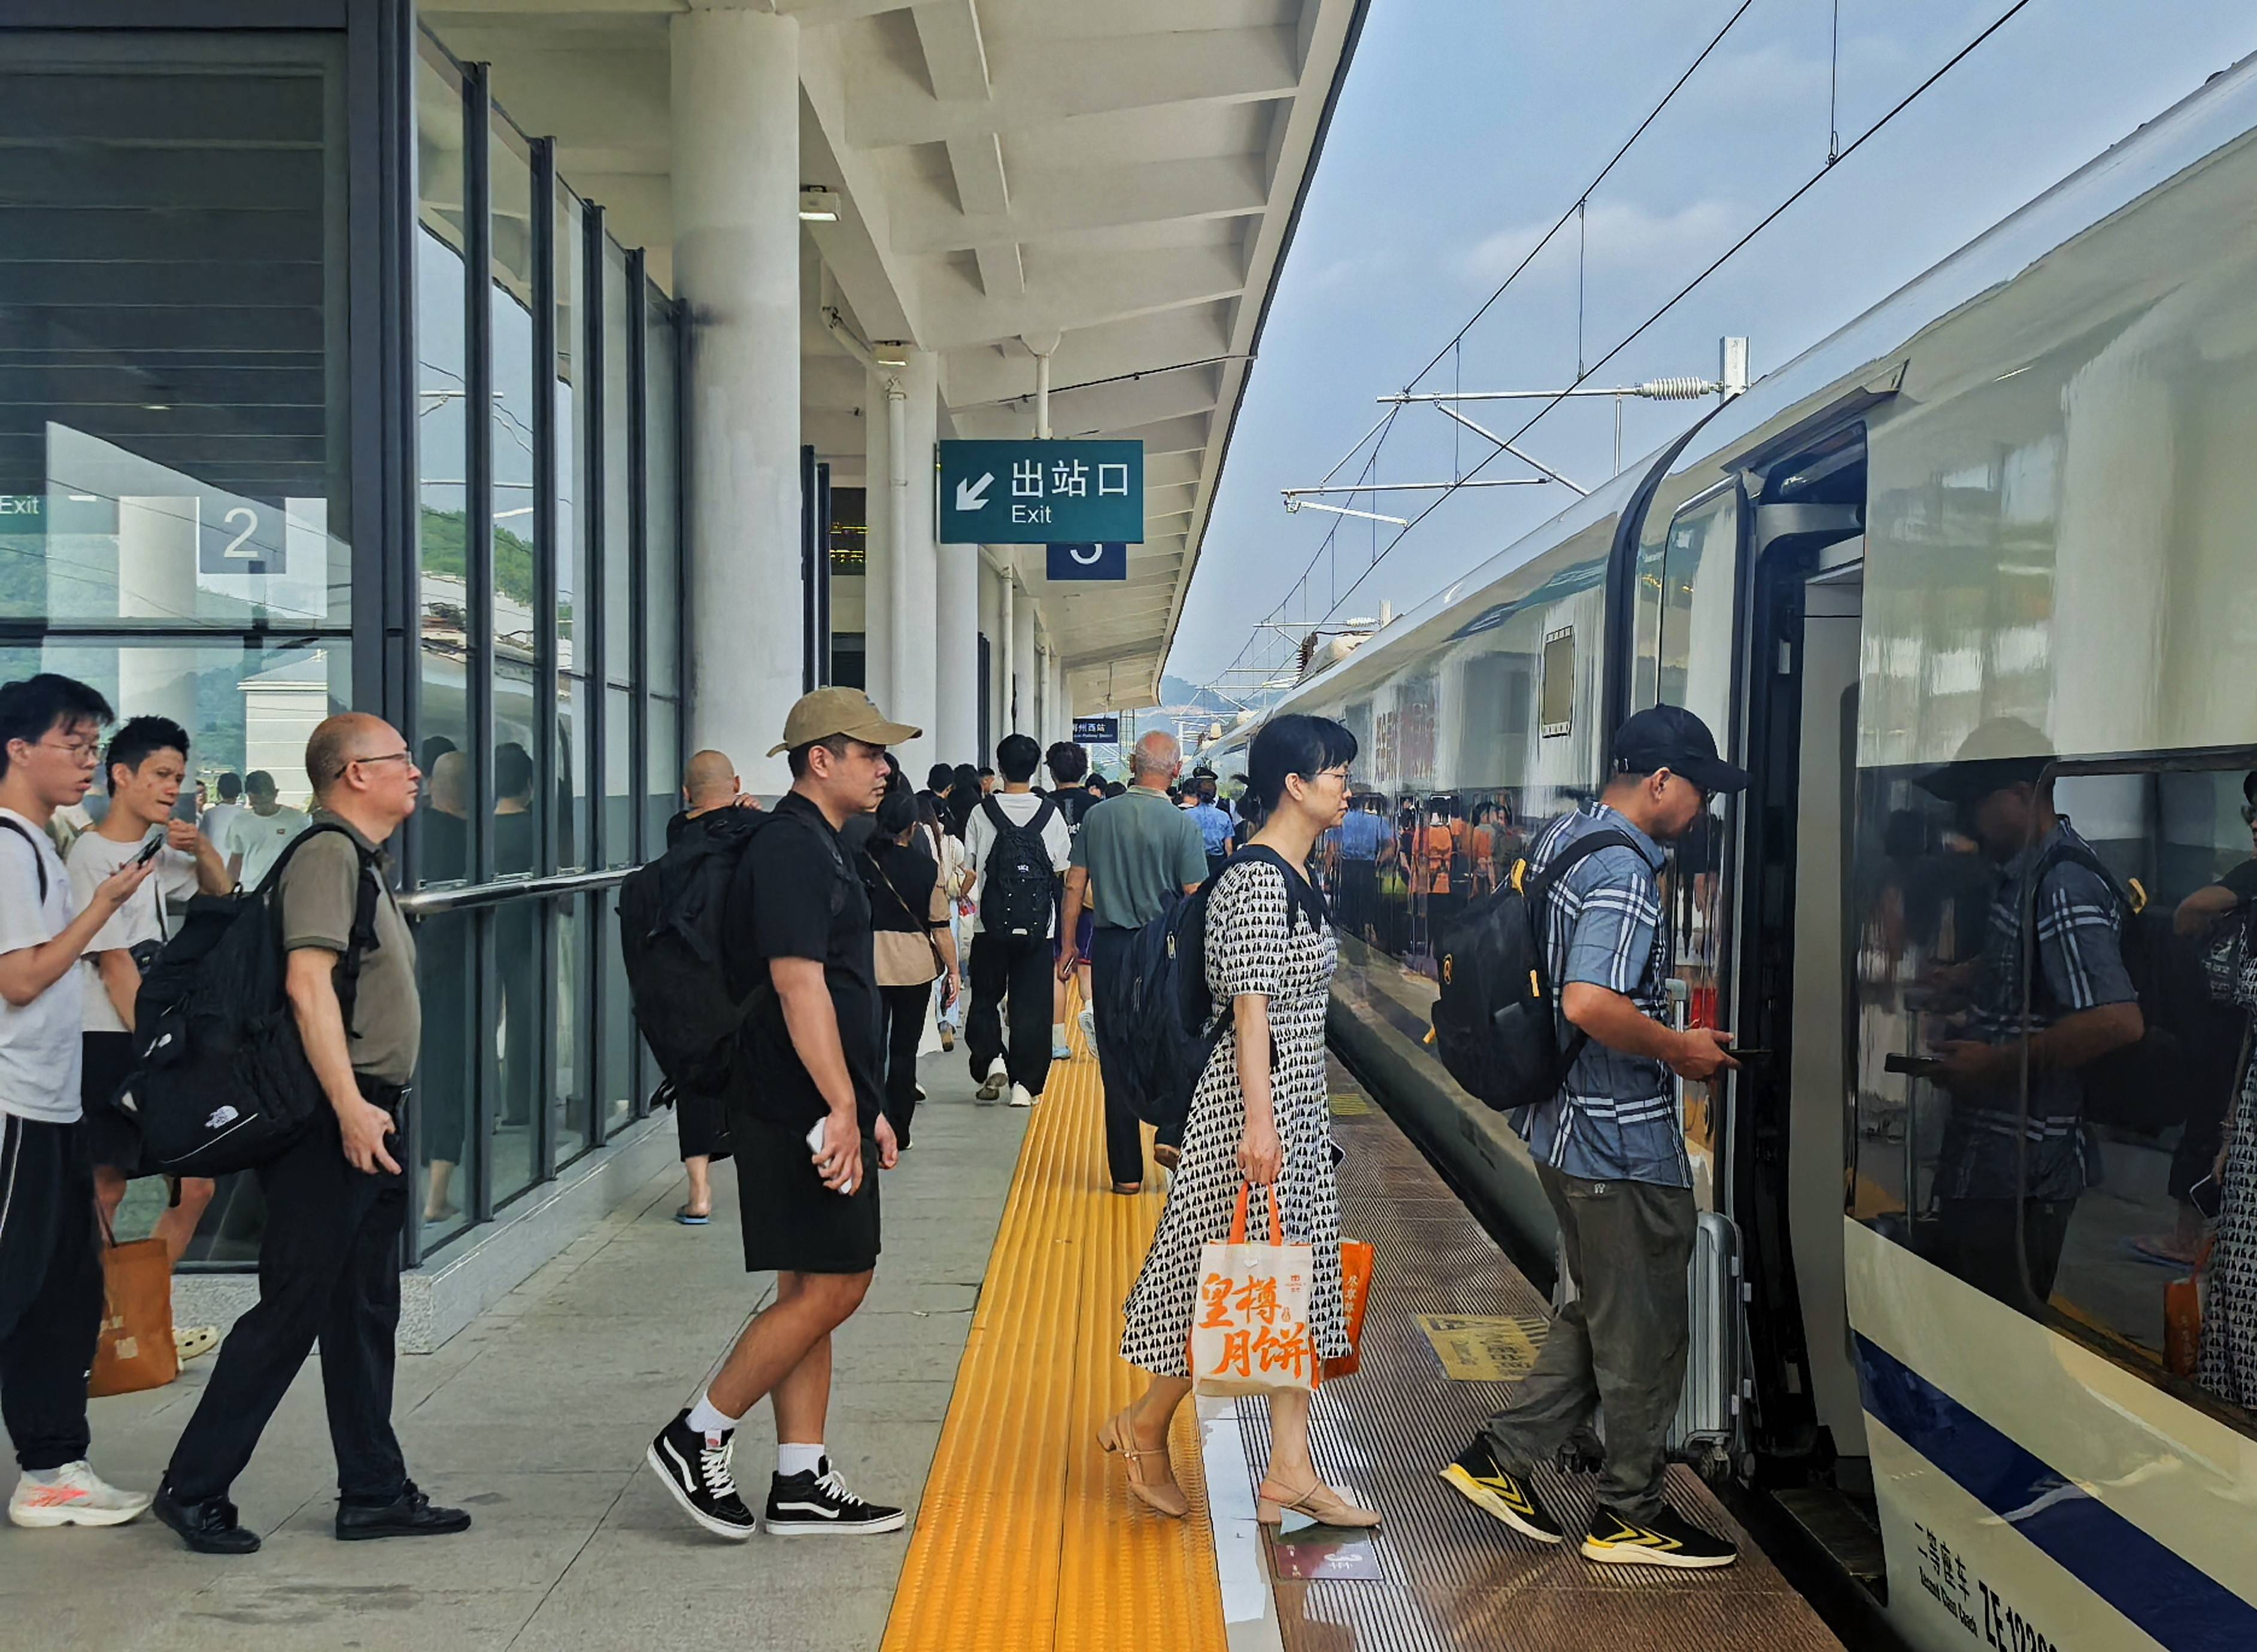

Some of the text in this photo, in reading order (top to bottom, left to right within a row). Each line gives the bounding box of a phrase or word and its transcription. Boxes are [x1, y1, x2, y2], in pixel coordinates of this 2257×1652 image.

[1012, 459, 1128, 497] 出站口
[0, 495, 40, 514] Exit
[1012, 505, 1052, 523] Exit
[223, 507, 259, 558] 2
[1198, 1272, 1282, 1329] 皇樽
[1211, 1322, 1309, 1380] 月饼
